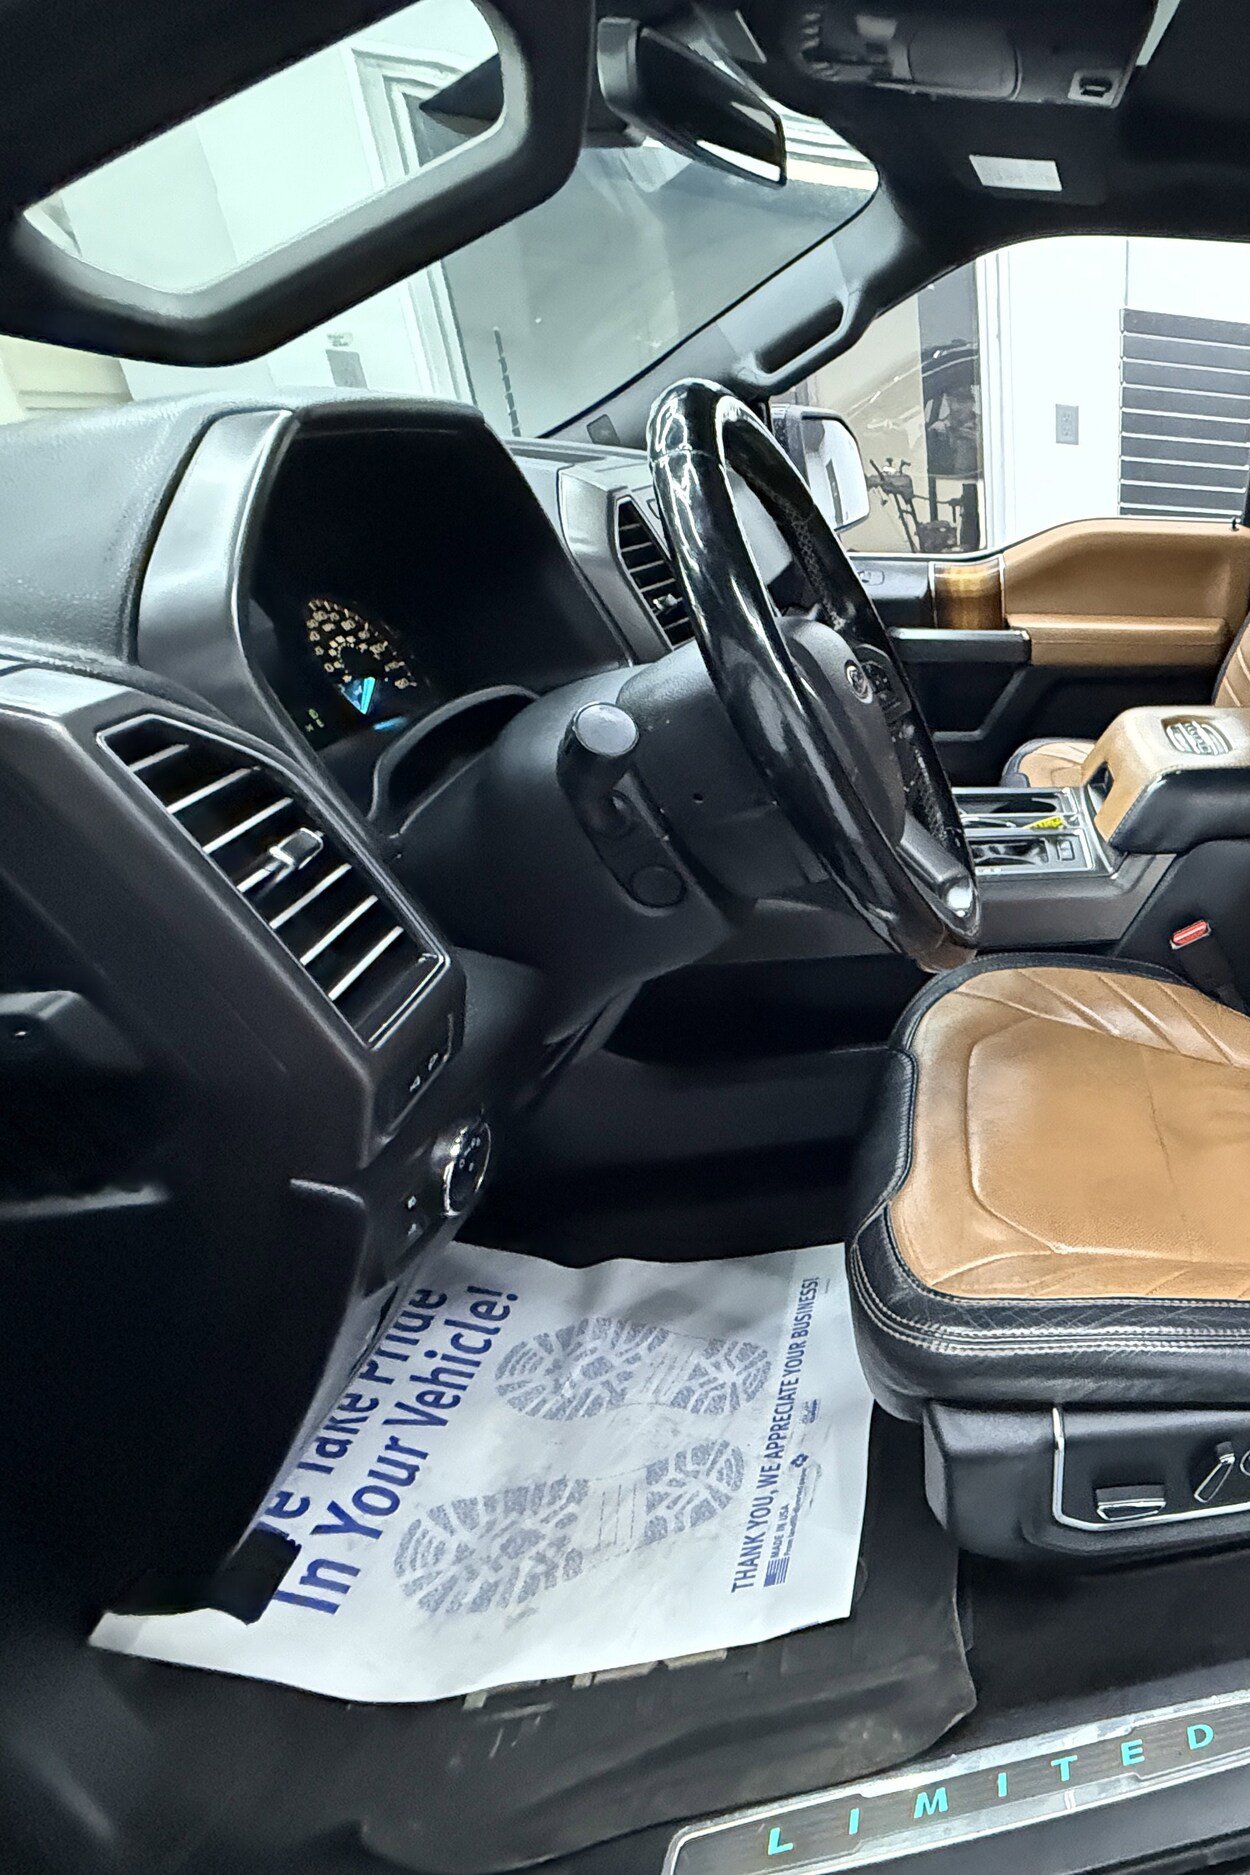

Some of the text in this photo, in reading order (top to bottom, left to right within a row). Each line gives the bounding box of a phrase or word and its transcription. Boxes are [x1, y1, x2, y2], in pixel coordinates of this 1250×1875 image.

[271, 1286, 519, 1615] In Your Vehicle!
[731, 1277, 820, 1593] THANK YOU, WE APPRECIATE YOUR BUSINESS!
[770, 1503, 790, 1558] MADE IN USA
[767, 1724, 1214, 1855] LIMITED
